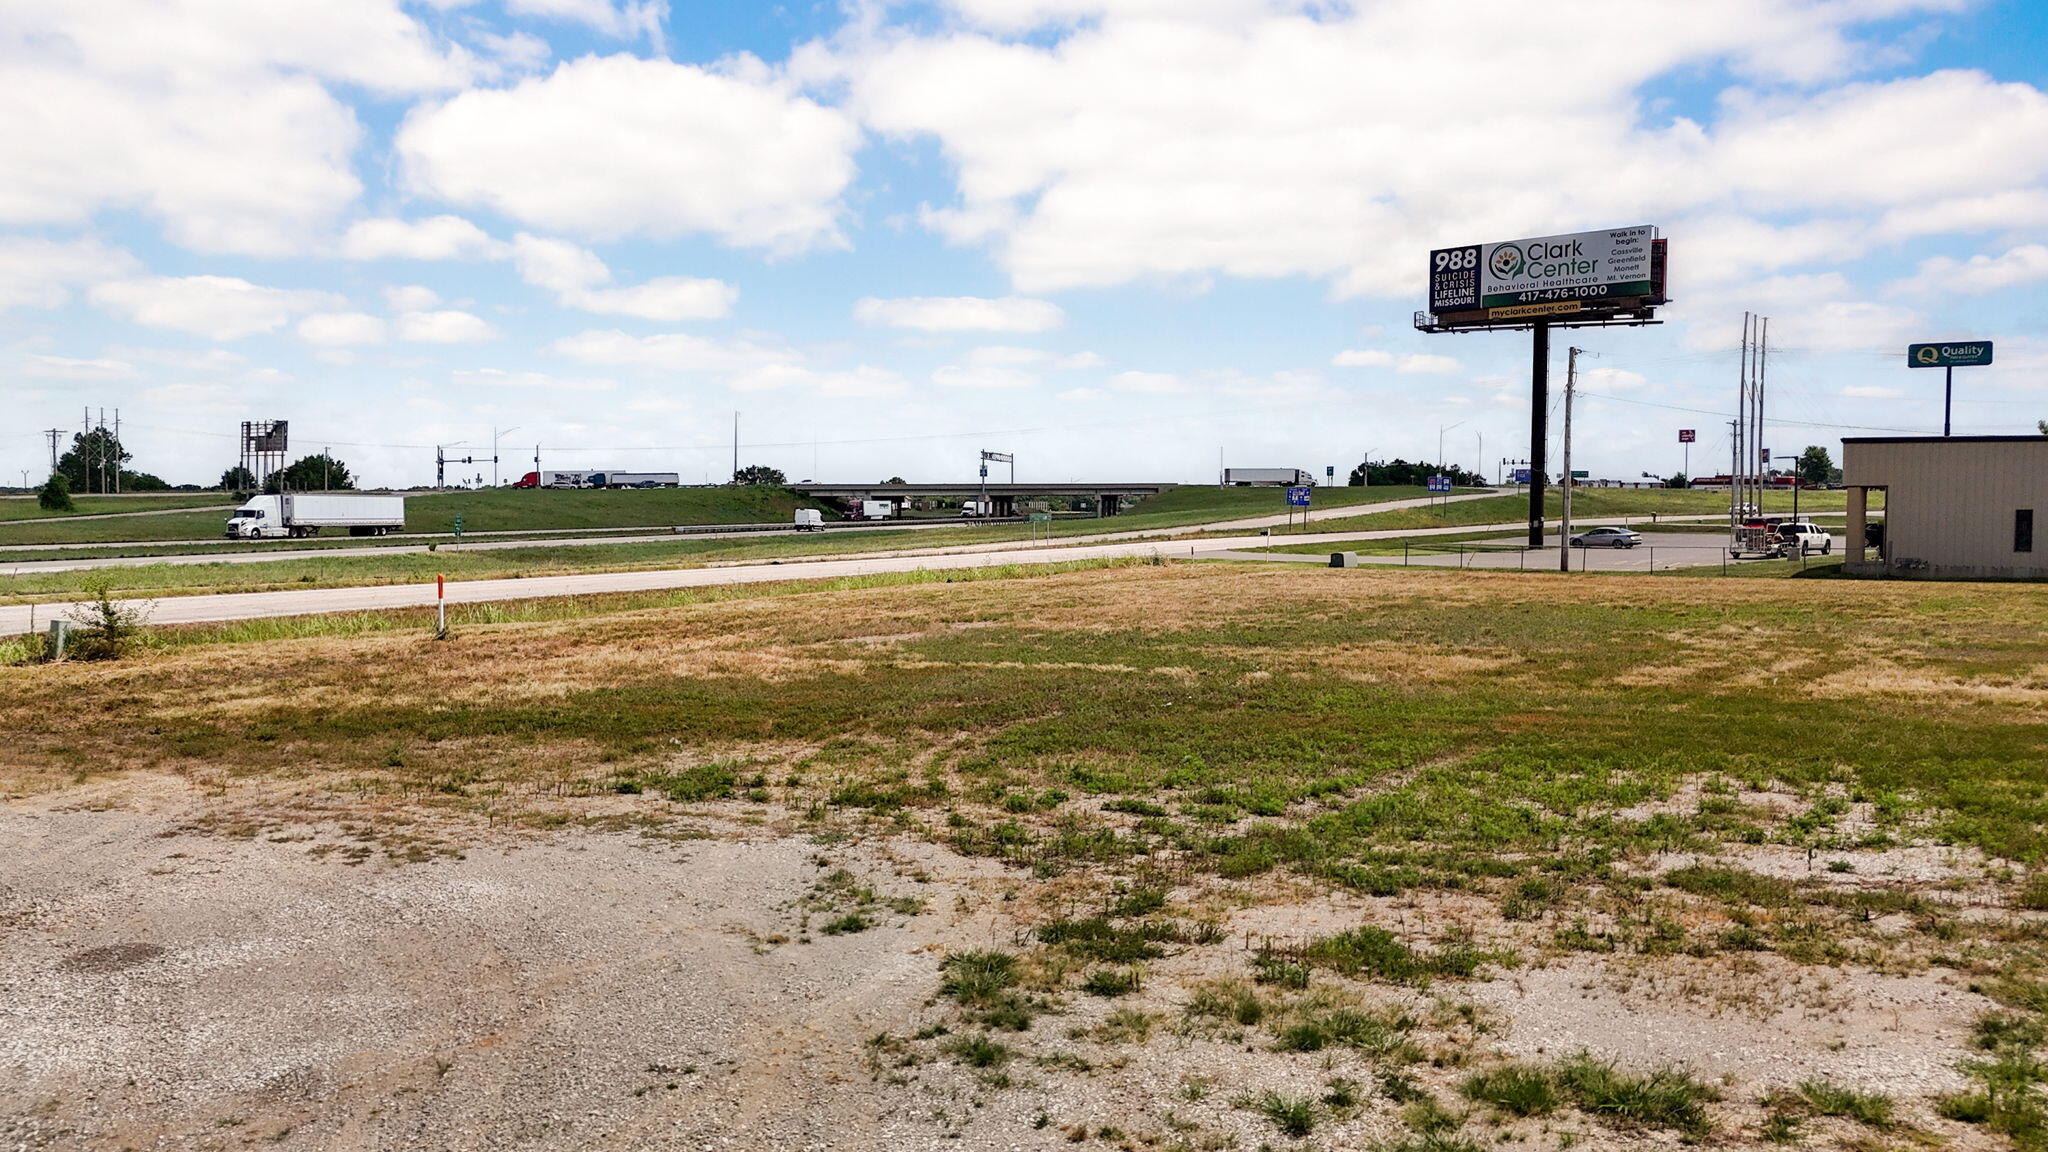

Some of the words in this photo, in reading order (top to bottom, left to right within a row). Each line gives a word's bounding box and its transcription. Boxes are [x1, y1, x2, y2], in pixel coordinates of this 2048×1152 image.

[1527, 240, 1583, 260] Clark
[1611, 247, 1643, 256] Cassville
[1435, 249, 1477, 272] 988
[1608, 255, 1646, 264] Greenfield
[1527, 258, 1599, 279] Center
[1614, 264, 1640, 272] Monett
[1435, 270, 1476, 282] SUICIDE
[1443, 279, 1475, 289] CRISIS
[1487, 281, 1539, 293] Behavioral
[1542, 276, 1598, 287] Healthcare
[1435, 287, 1475, 300] LIFELINE
[1518, 285, 1608, 302] 417-476-1000
[1434, 296, 1475, 307] MISSOURI
[1491, 303, 1578, 318] myclarkcenter.com
[1917, 346, 1940, 364] Q
[1941, 345, 1984, 357] Quality
